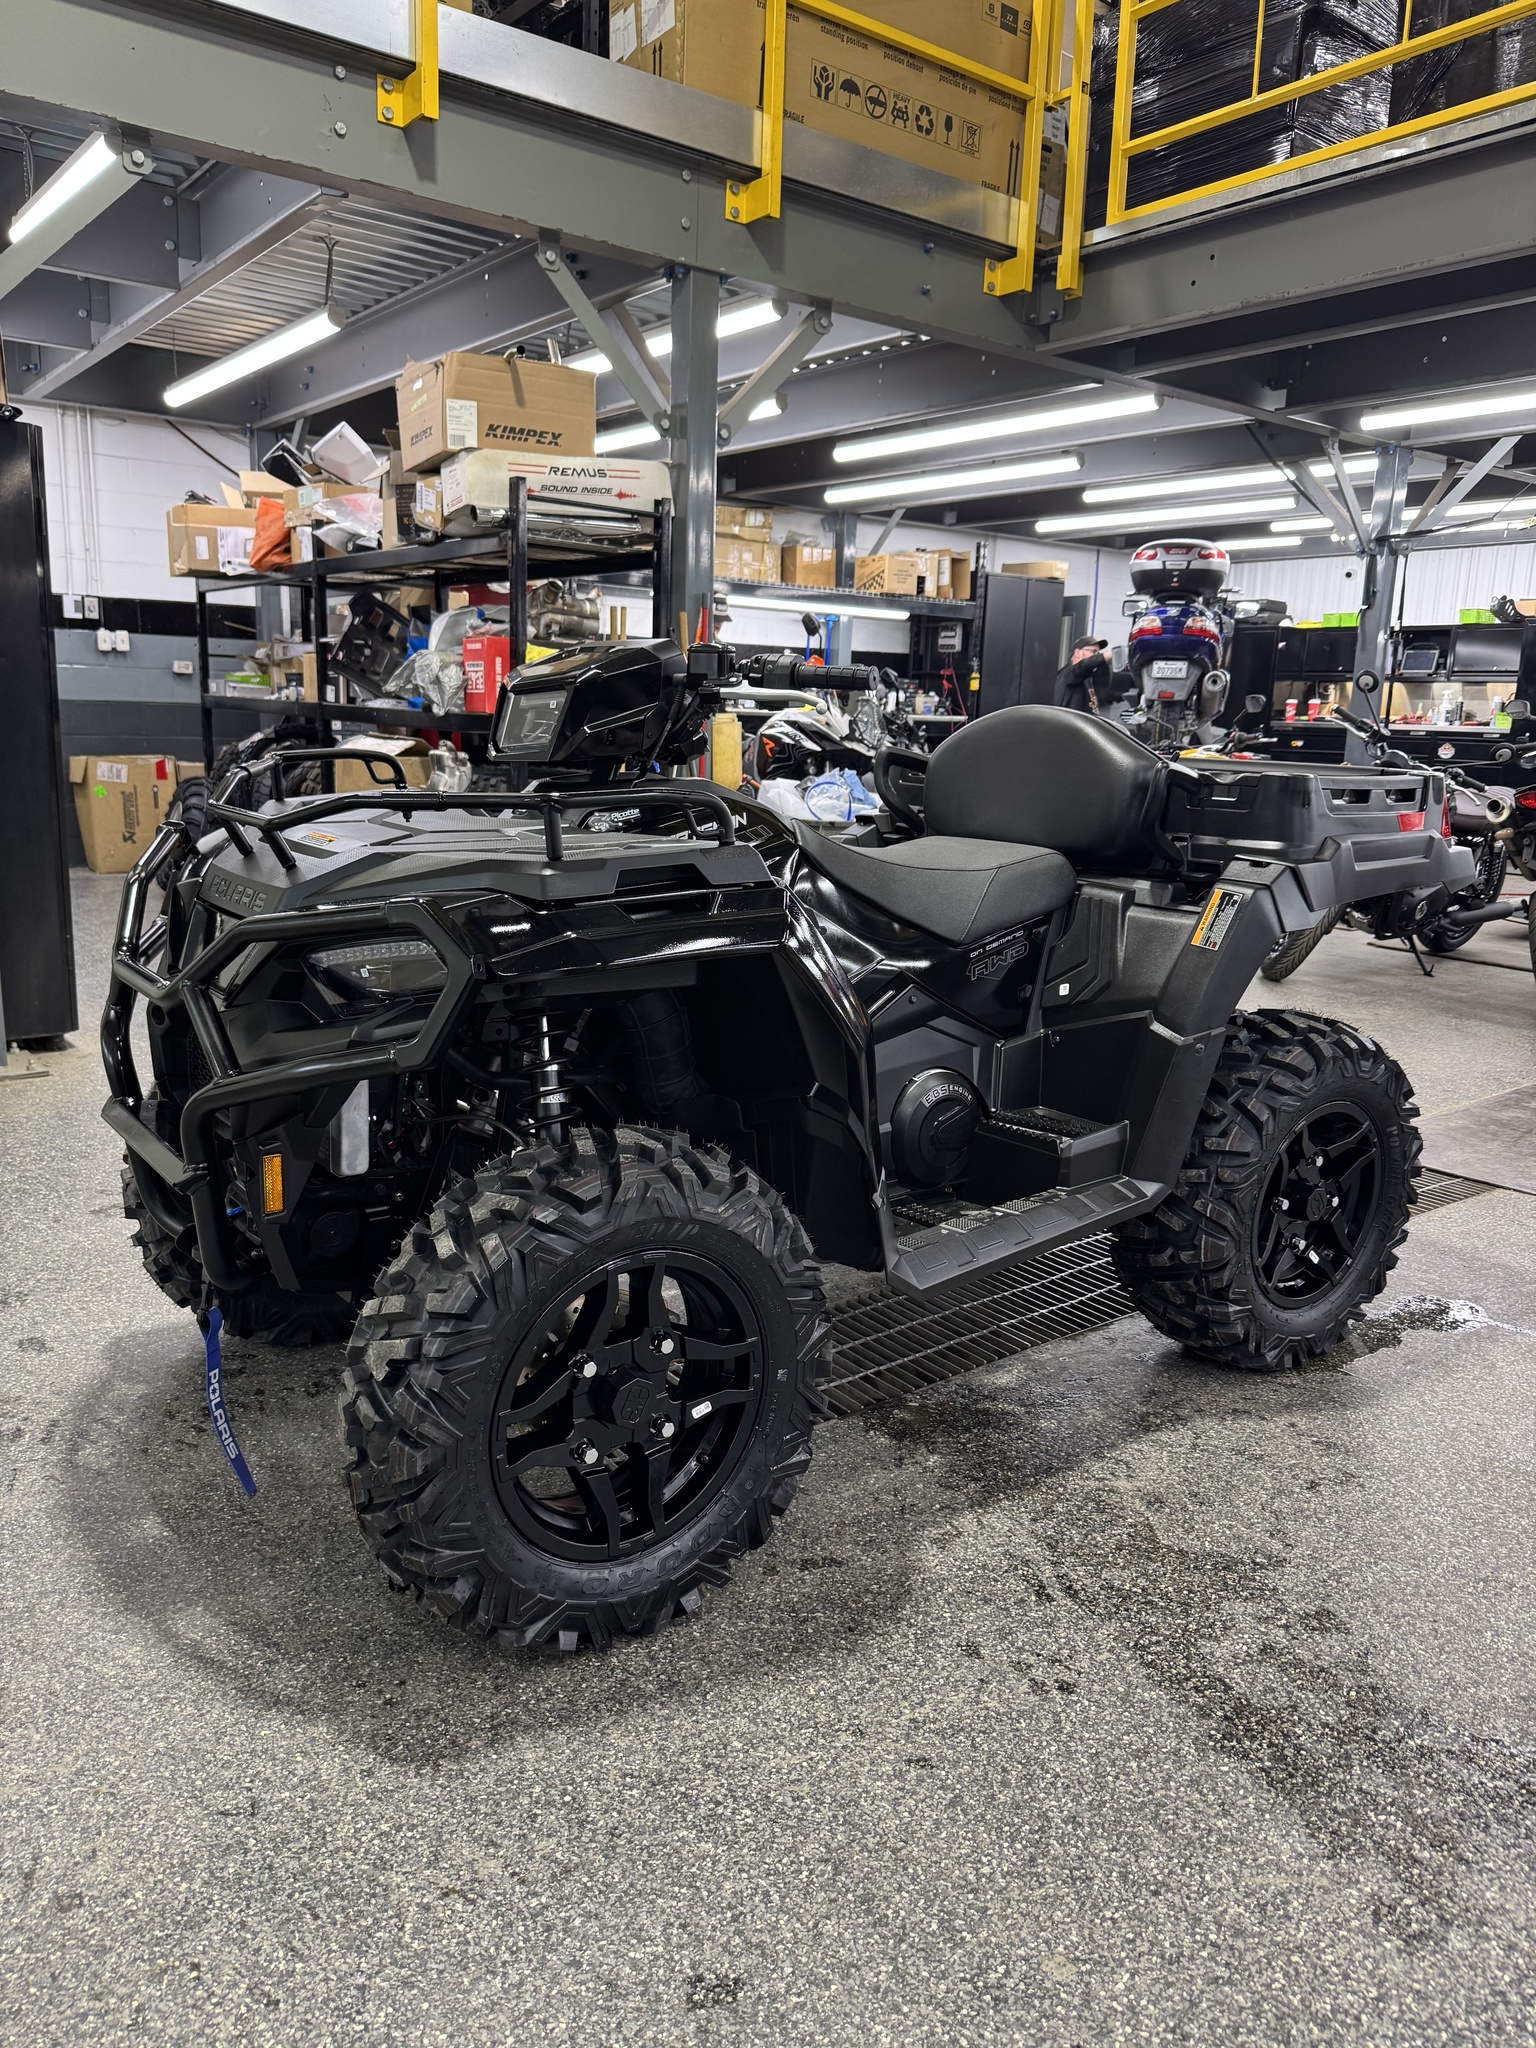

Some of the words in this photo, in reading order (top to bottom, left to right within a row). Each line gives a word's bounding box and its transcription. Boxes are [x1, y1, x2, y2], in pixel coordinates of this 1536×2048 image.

[820, 24, 845, 43] standing
[846, 36, 869, 51] position
[883, 51, 905, 66] position
[905, 59, 924, 74] debout
[939, 73, 961, 89] posición
[961, 84, 968, 92] de
[968, 85, 977, 95] pie
[893, 92, 911, 105] HEAVY
[485, 423, 563, 448] KIMPEX
[548, 466, 608, 479] REMUS
[540, 484, 578, 493] SOUND
[581, 486, 613, 495] INSIDE
[611, 808, 640, 820] Picotte
[208, 875, 268, 912] POLARIS
[1201, 902, 1216, 925] WARNING
[971, 941, 1029, 981] AWD
[924, 1085, 948, 1104] EBS
[949, 1084, 973, 1102] ENGINE
[208, 1368, 239, 1459] POLARIS
